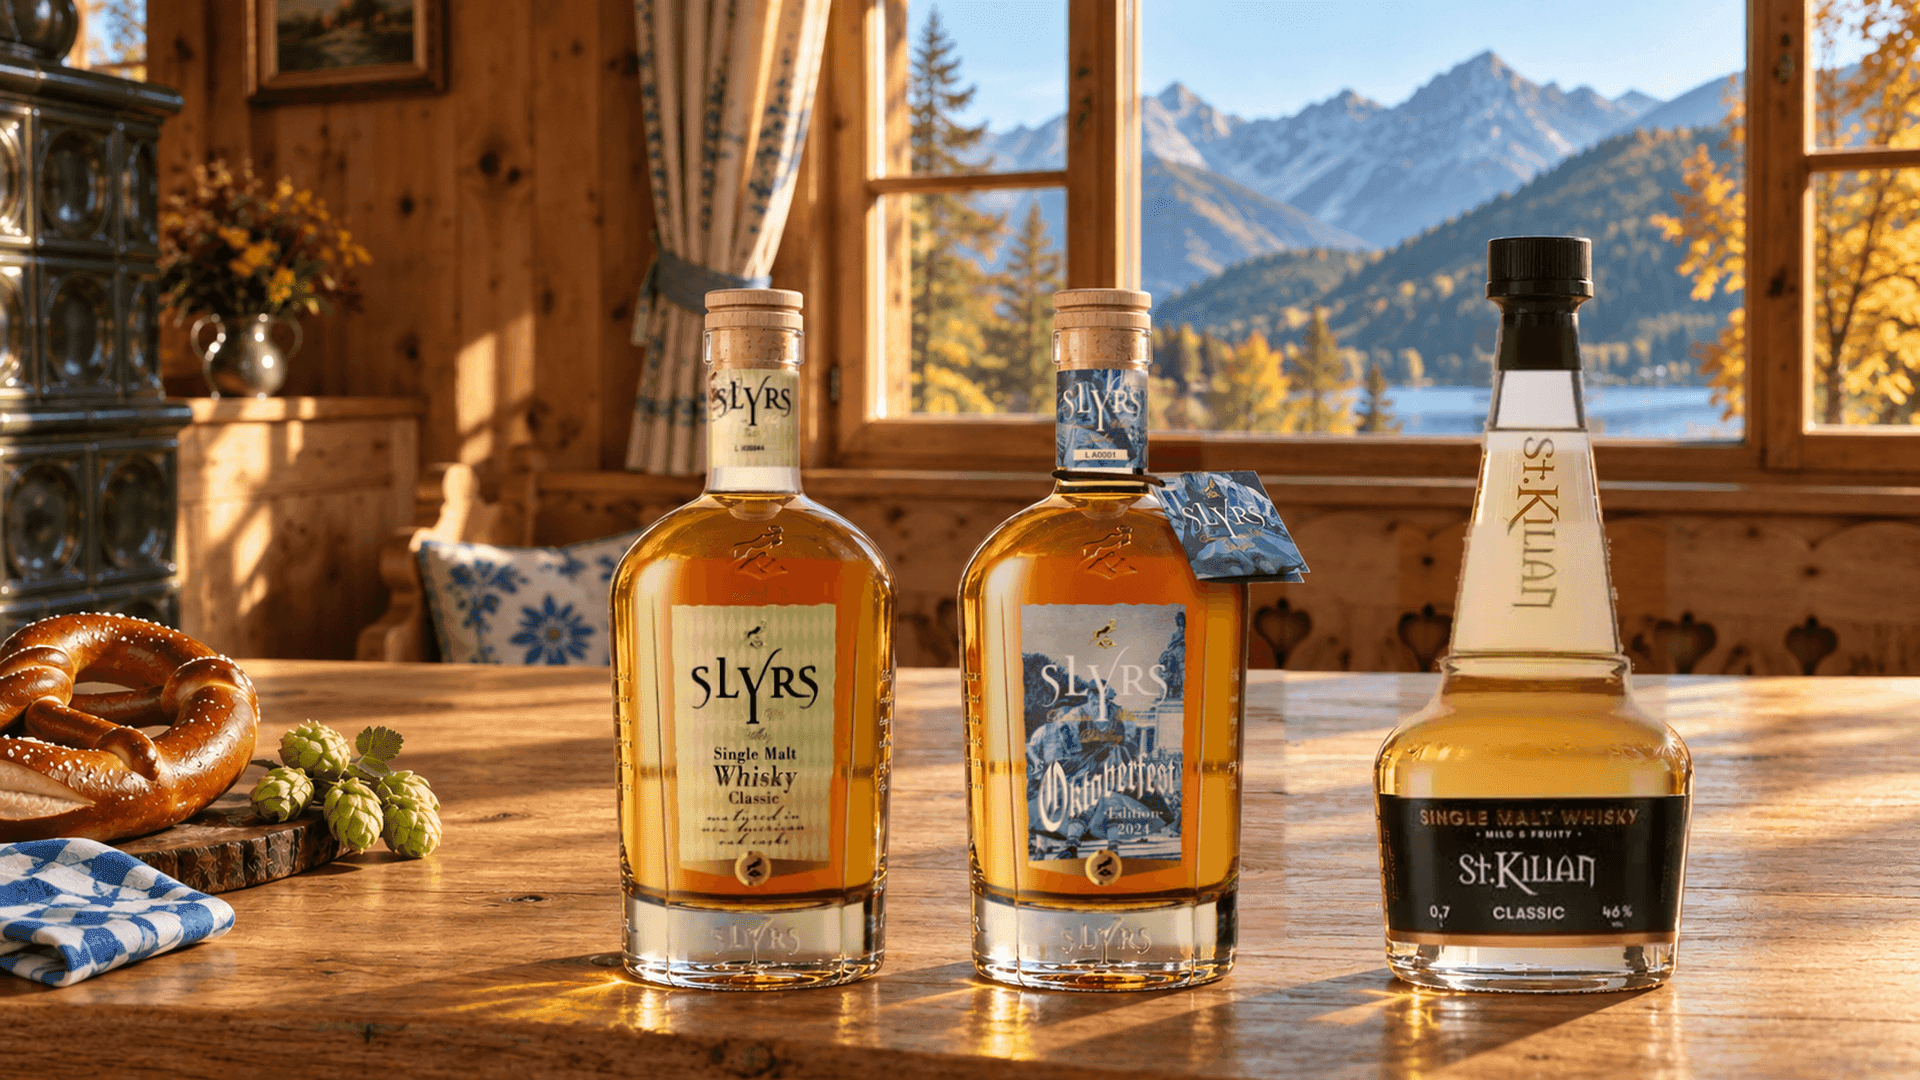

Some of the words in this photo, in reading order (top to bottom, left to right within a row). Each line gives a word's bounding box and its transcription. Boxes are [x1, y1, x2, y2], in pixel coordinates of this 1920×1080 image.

[717, 375, 791, 426] SLYRS
[1063, 376, 1141, 432] SLYRS
[1182, 498, 1265, 538] SLYRS
[691, 648, 819, 724] SLYRS
[1041, 646, 1168, 722] SLYRS
[713, 747, 759, 764] Single
[765, 747, 796, 760] Malt
[713, 765, 797, 793] Whisky
[1038, 753, 1176, 833] Oktoberfest
[728, 791, 780, 805] Classic
[1117, 823, 1150, 835] 2024
[1419, 809, 1488, 826] SINGLE
[1496, 809, 1552, 826] MALT
[1561, 808, 1639, 826] WHISKY
[1485, 830, 1514, 838] MILD
[1530, 830, 1572, 838] FRUITY
[1429, 904, 1450, 919] 0,7
[1493, 906, 1565, 920] CLASSIC
[1061, 918, 1152, 964] SLYRS
